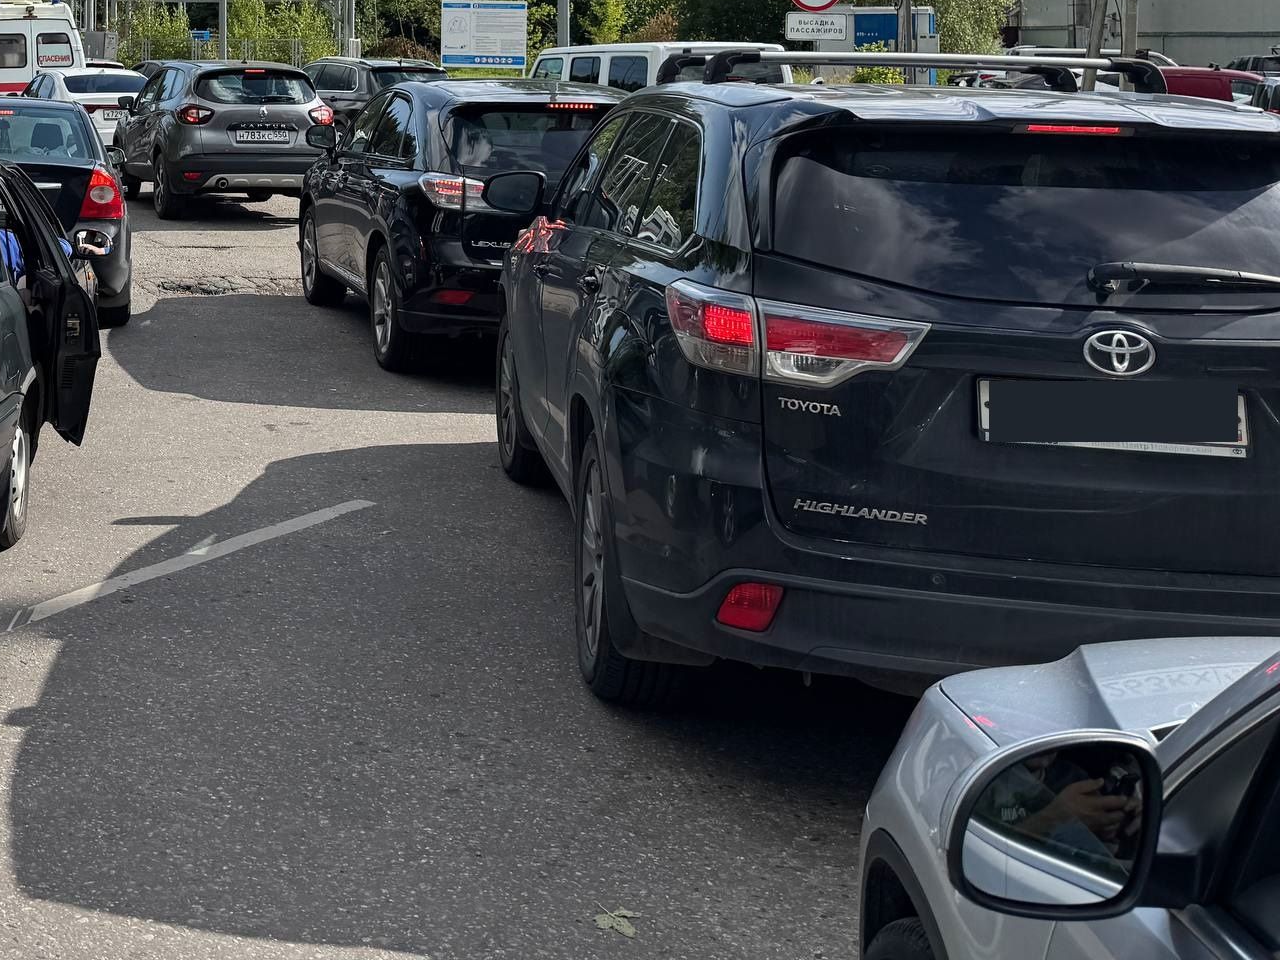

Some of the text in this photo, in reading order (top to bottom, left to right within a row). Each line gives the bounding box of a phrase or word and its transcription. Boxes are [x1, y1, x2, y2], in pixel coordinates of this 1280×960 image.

[471, 240, 511, 248] LEXUS
[778, 397, 842, 417] TOYOTA
[793, 498, 928, 525] HIGHLANDER
